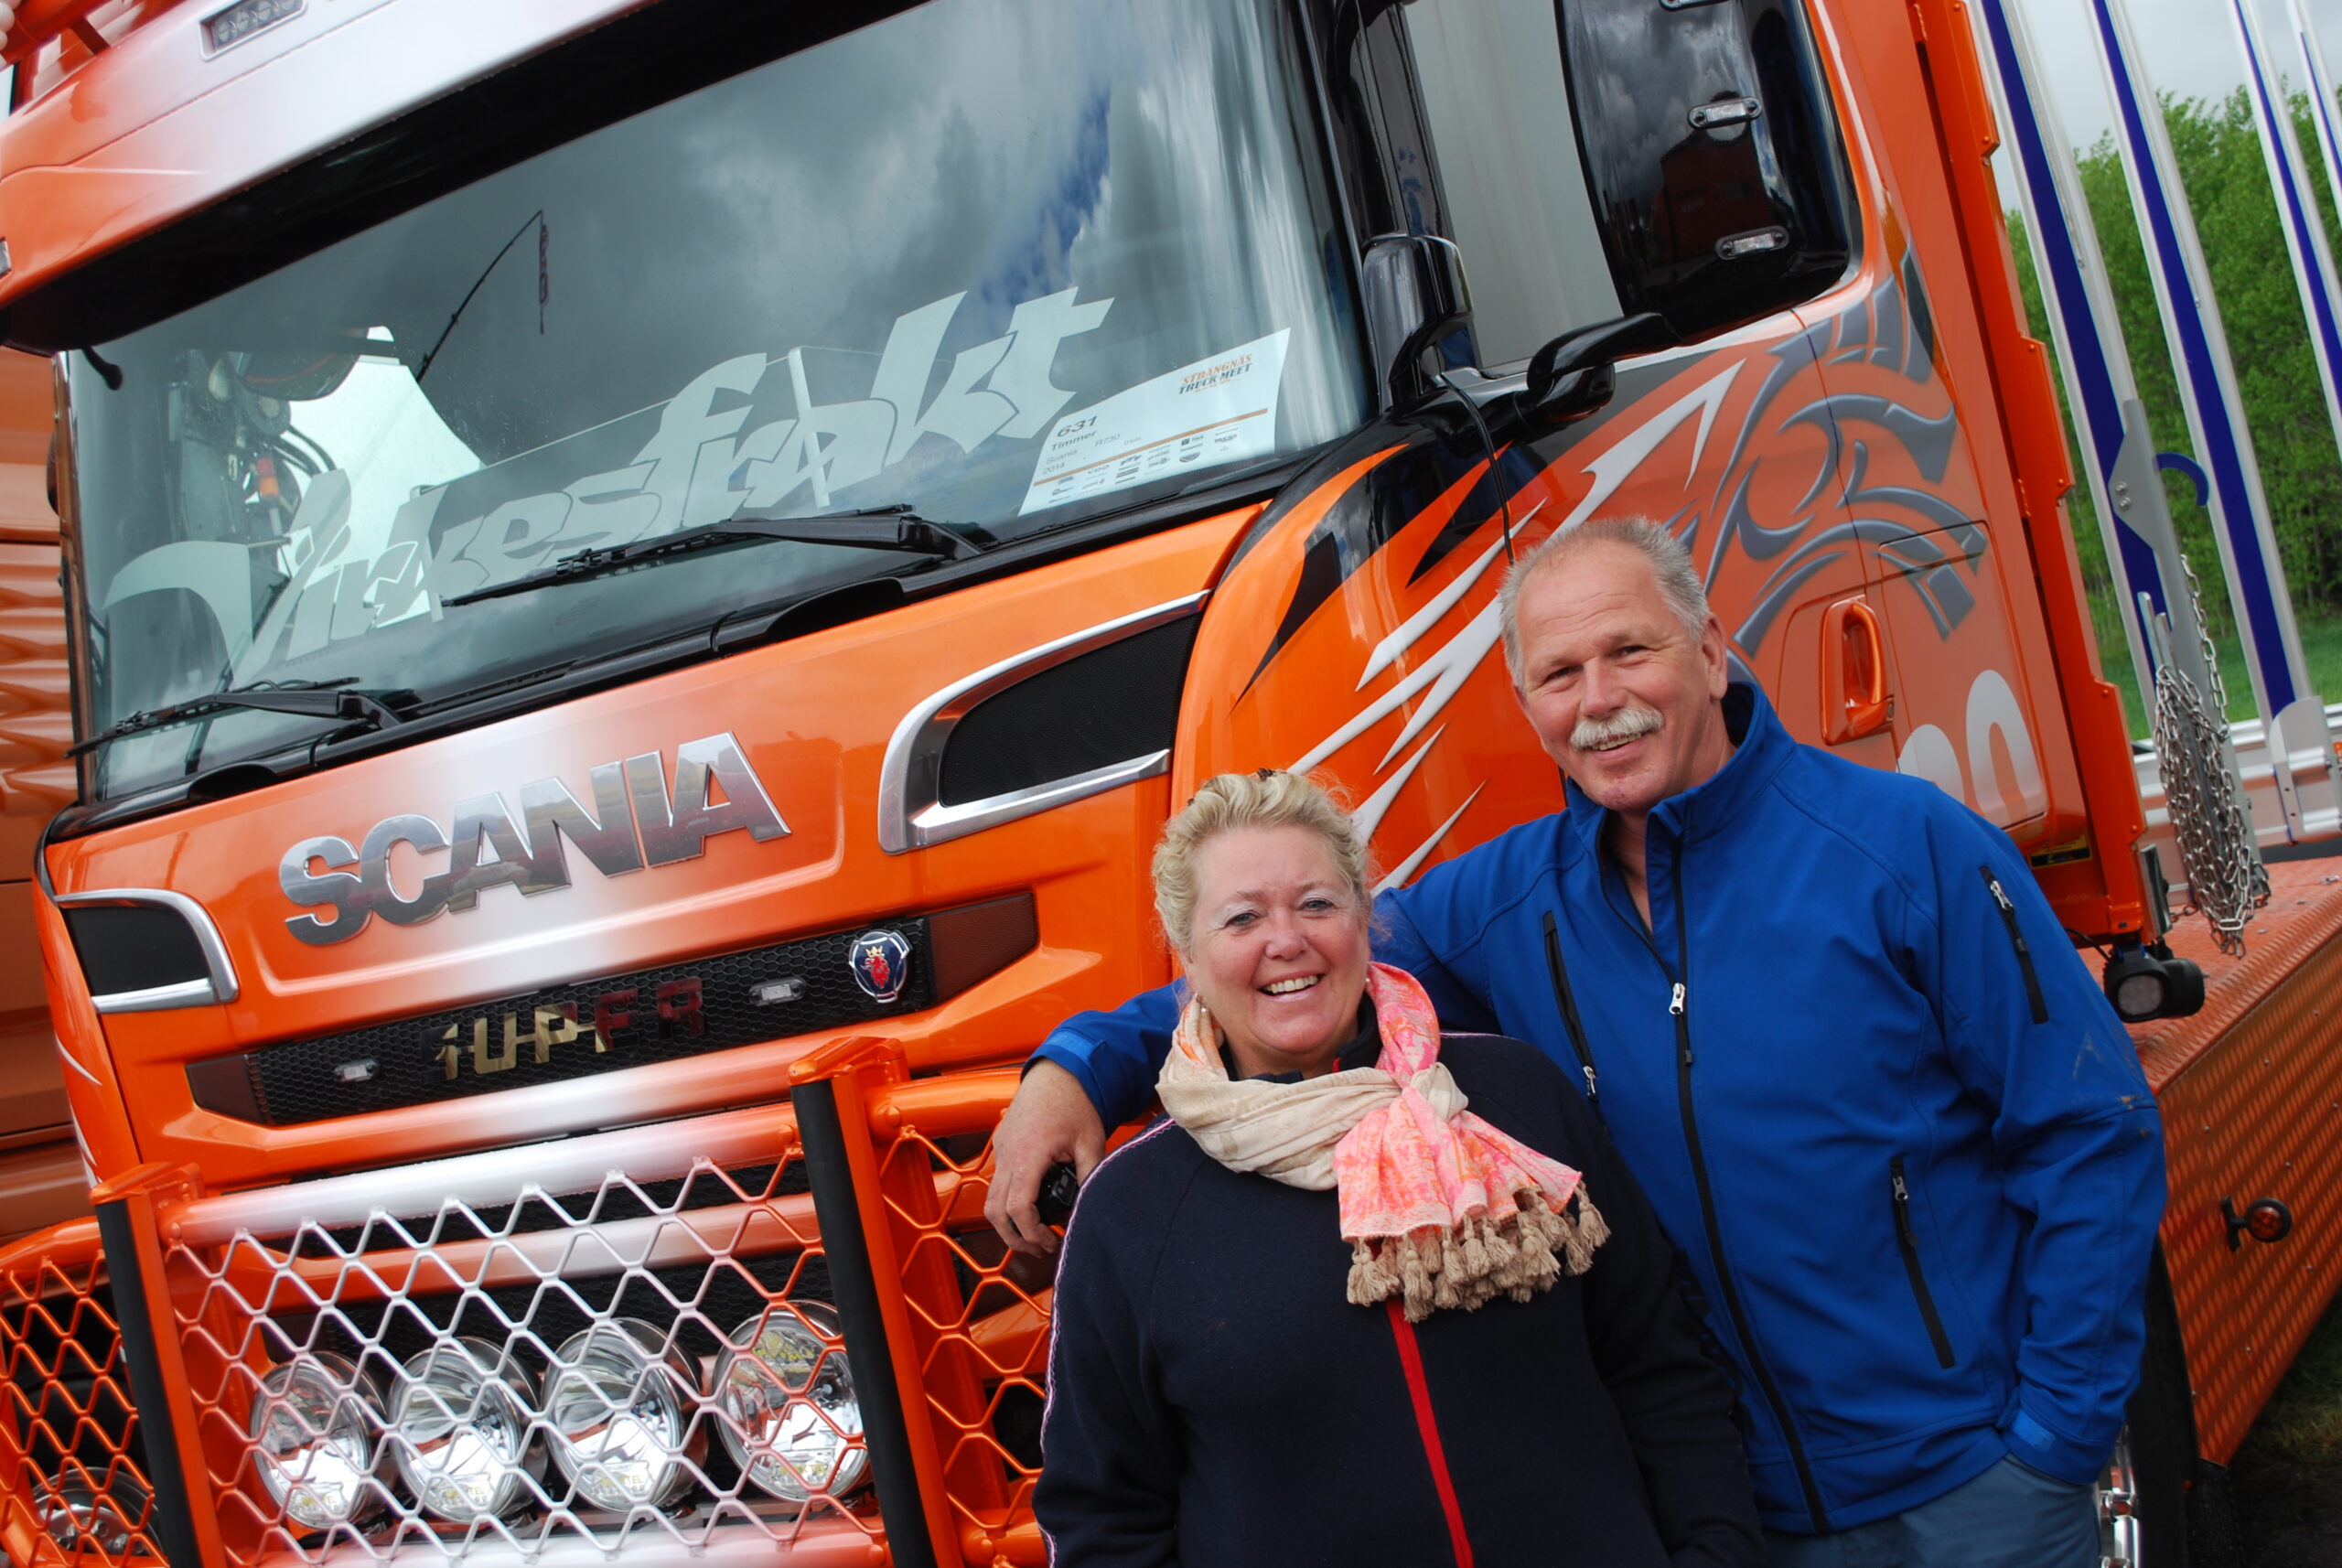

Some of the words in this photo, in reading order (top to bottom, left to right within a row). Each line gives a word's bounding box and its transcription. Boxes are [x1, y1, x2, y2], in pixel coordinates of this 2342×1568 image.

[1179, 375, 1218, 394] TRUCK
[1219, 363, 1252, 380] MEET
[1051, 431, 1098, 451] Timmer
[1058, 415, 1098, 437] 631
[102, 286, 1114, 693] Virkesfrakt
[278, 731, 792, 946] SCANIA
